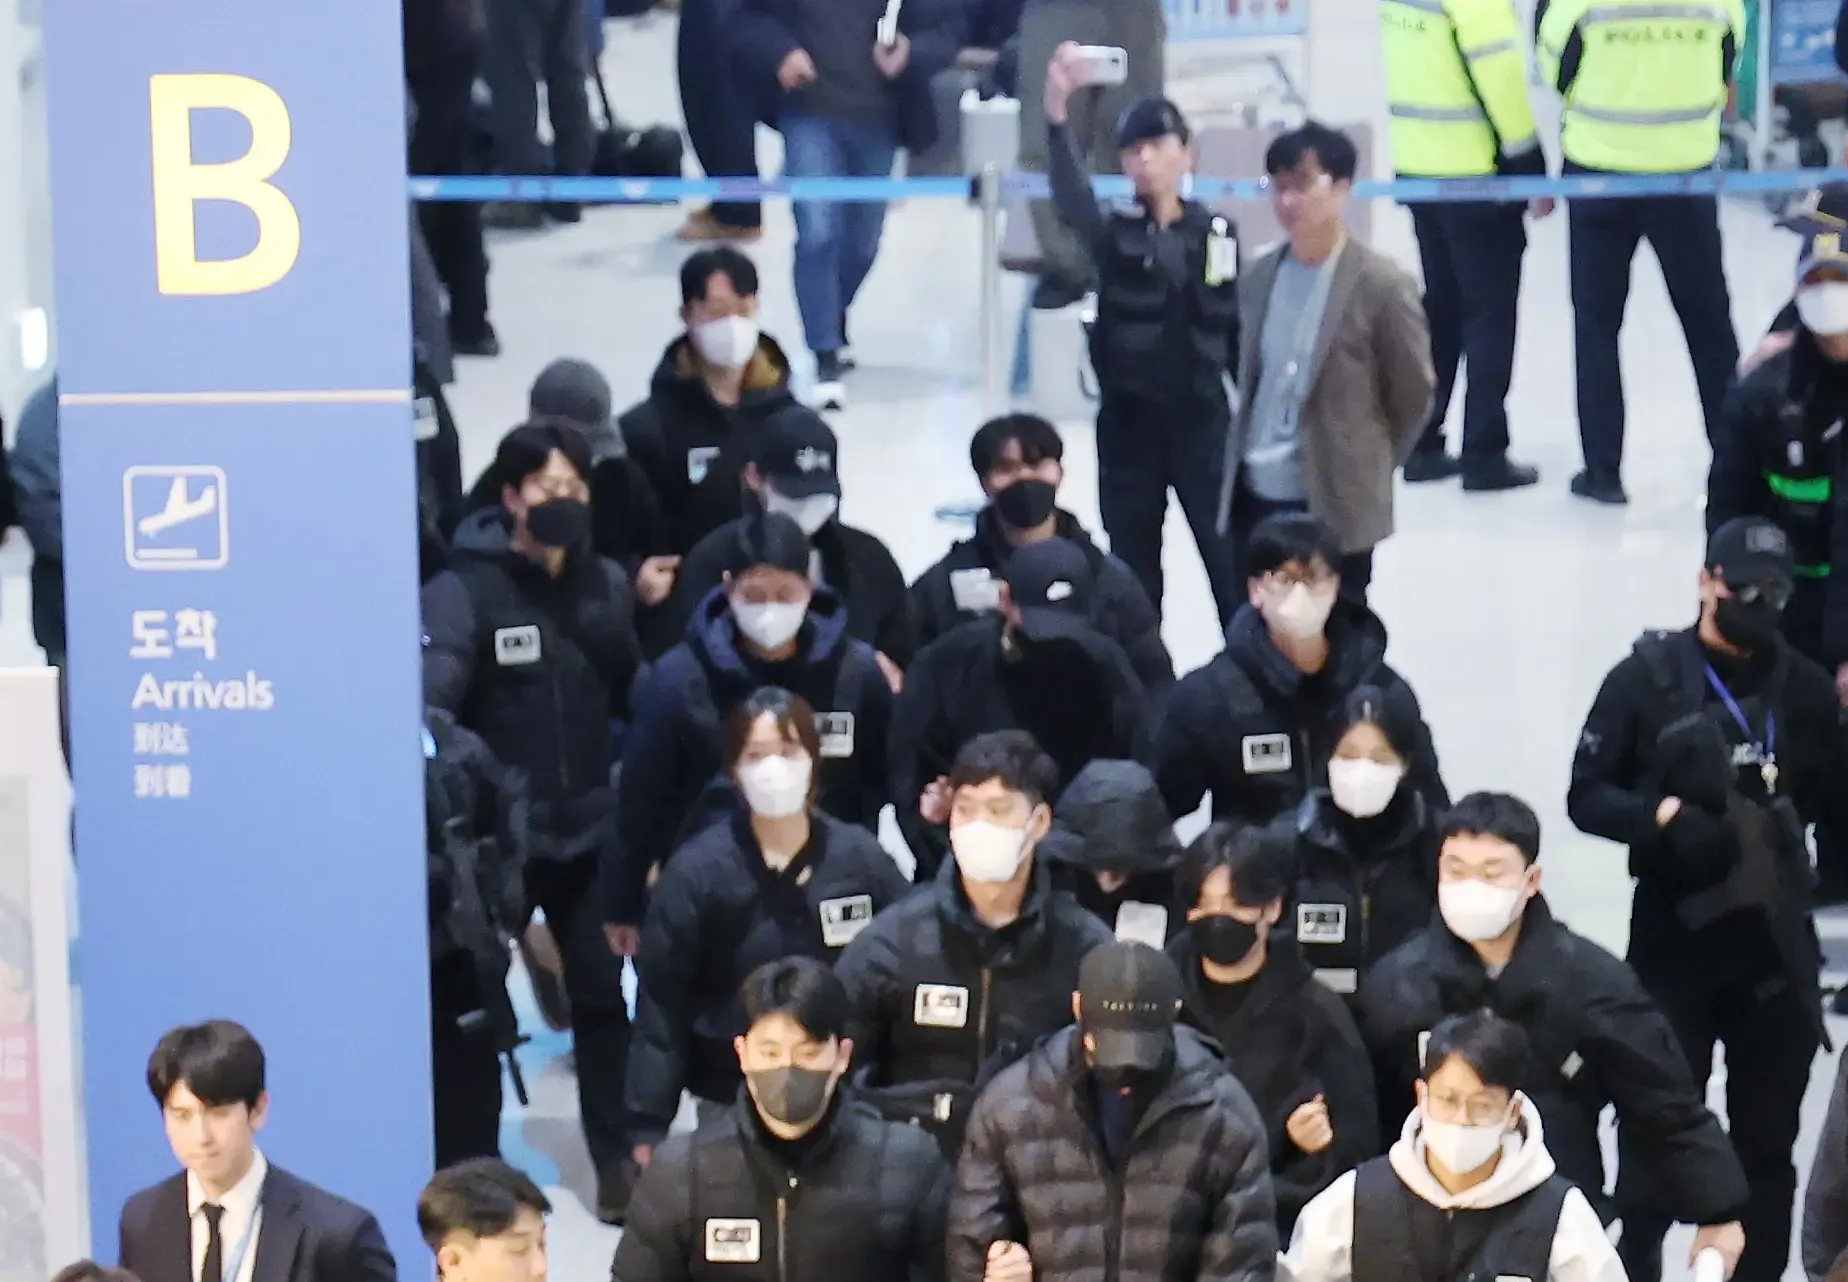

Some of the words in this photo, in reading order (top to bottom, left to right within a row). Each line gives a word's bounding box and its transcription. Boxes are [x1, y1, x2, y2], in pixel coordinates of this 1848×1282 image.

[149, 73, 301, 295] B
[129, 608, 217, 660] 도착
[131, 670, 274, 709] Arrivals
